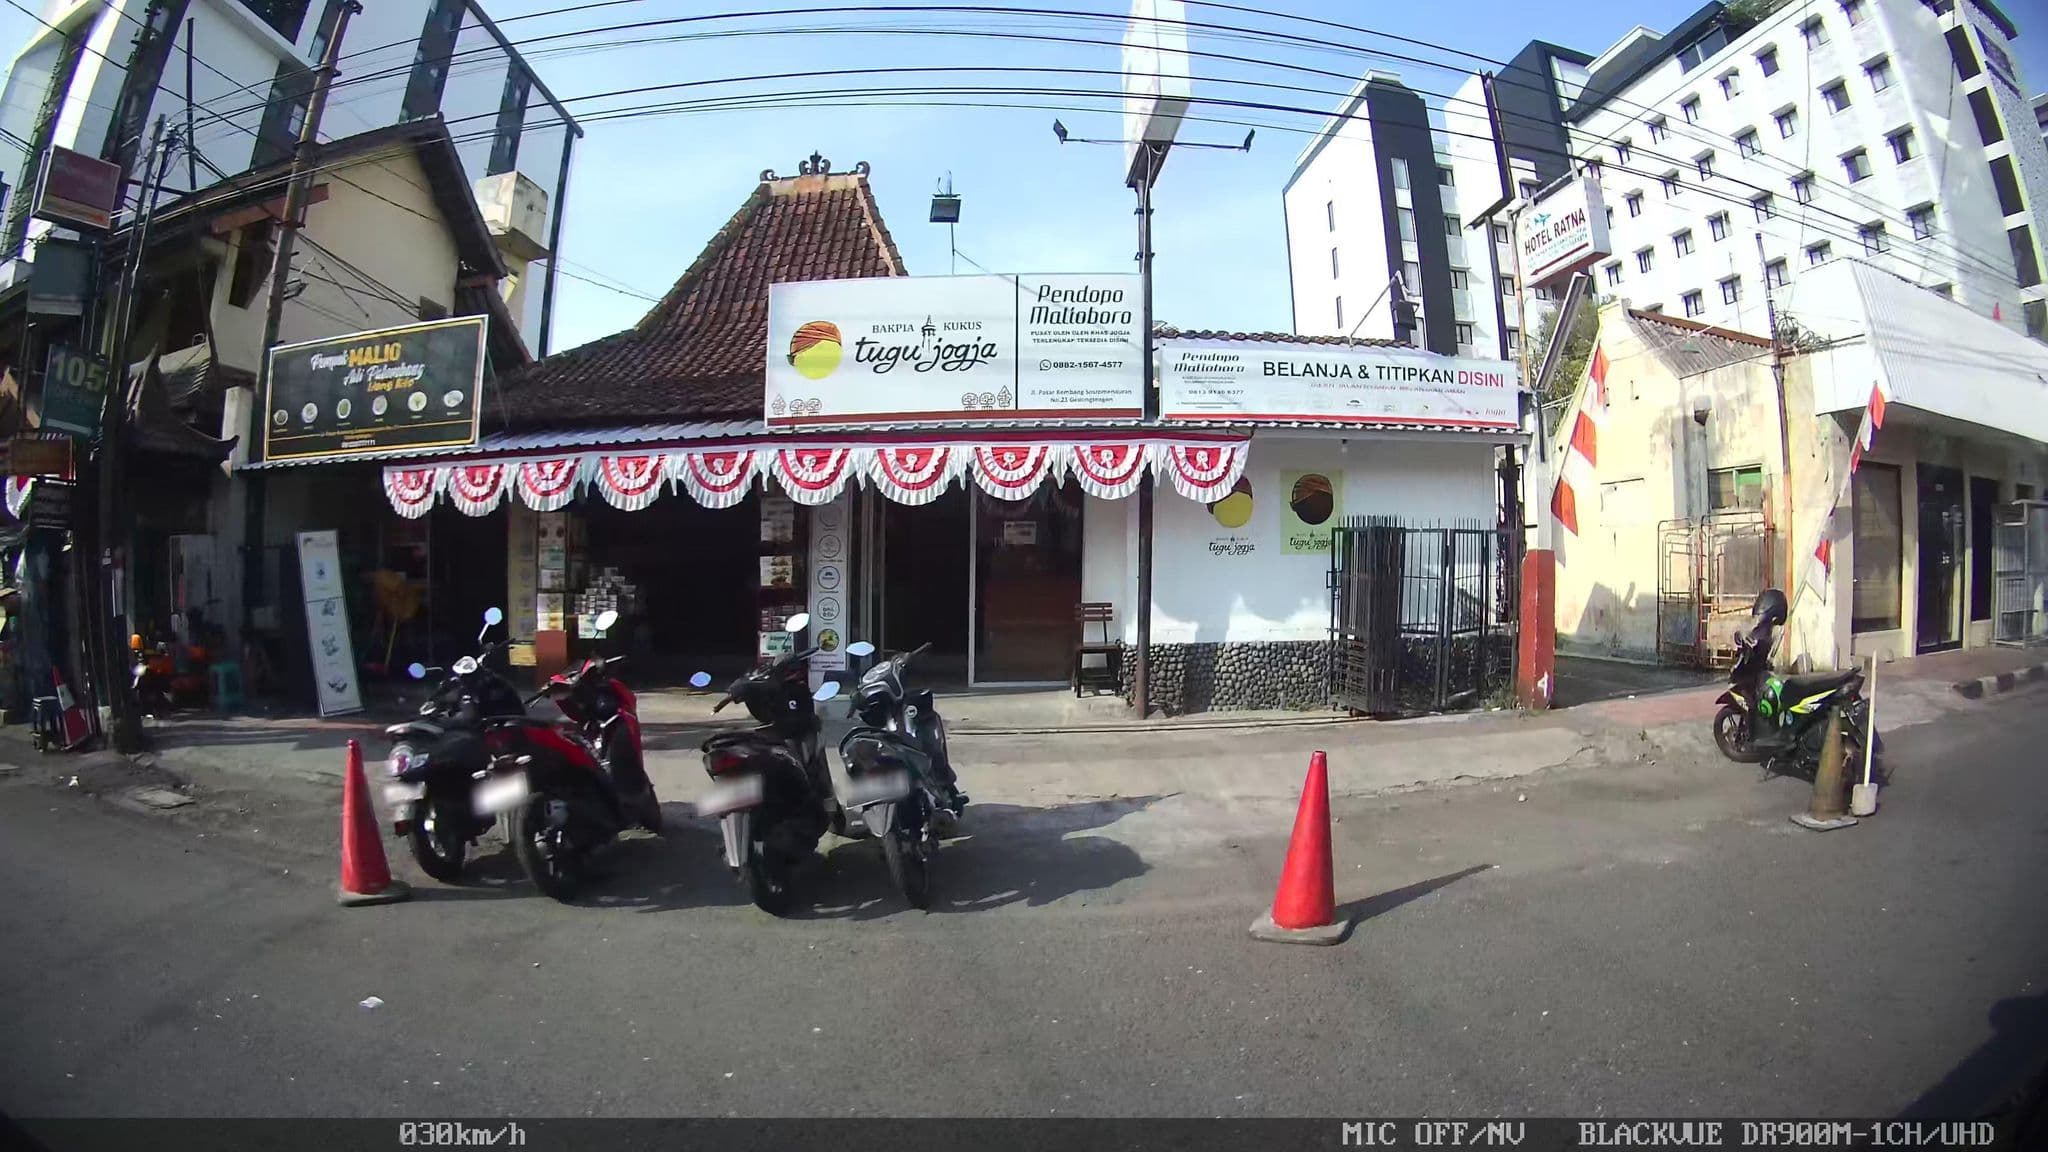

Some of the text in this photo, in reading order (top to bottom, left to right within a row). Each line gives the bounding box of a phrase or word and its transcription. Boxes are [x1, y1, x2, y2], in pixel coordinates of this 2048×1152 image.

[1524, 228, 1552, 256] HOTEL
[1553, 207, 1586, 239] RATNA
[1037, 284, 1124, 306] Pendopo
[1030, 306, 1132, 325] Malioboro
[872, 321, 982, 334] BAKPIA KUKUS
[349, 342, 402, 367] MALIO
[855, 336, 998, 374] tugu jogja
[1181, 352, 1240, 362] Pendopo
[52, 351, 105, 393] 105
[1263, 361, 1504, 388] BELANJA & TITIPKAN DISINI
[1208, 542, 1255, 555] tugu jogja
[1289, 537, 1310, 550] tugu
